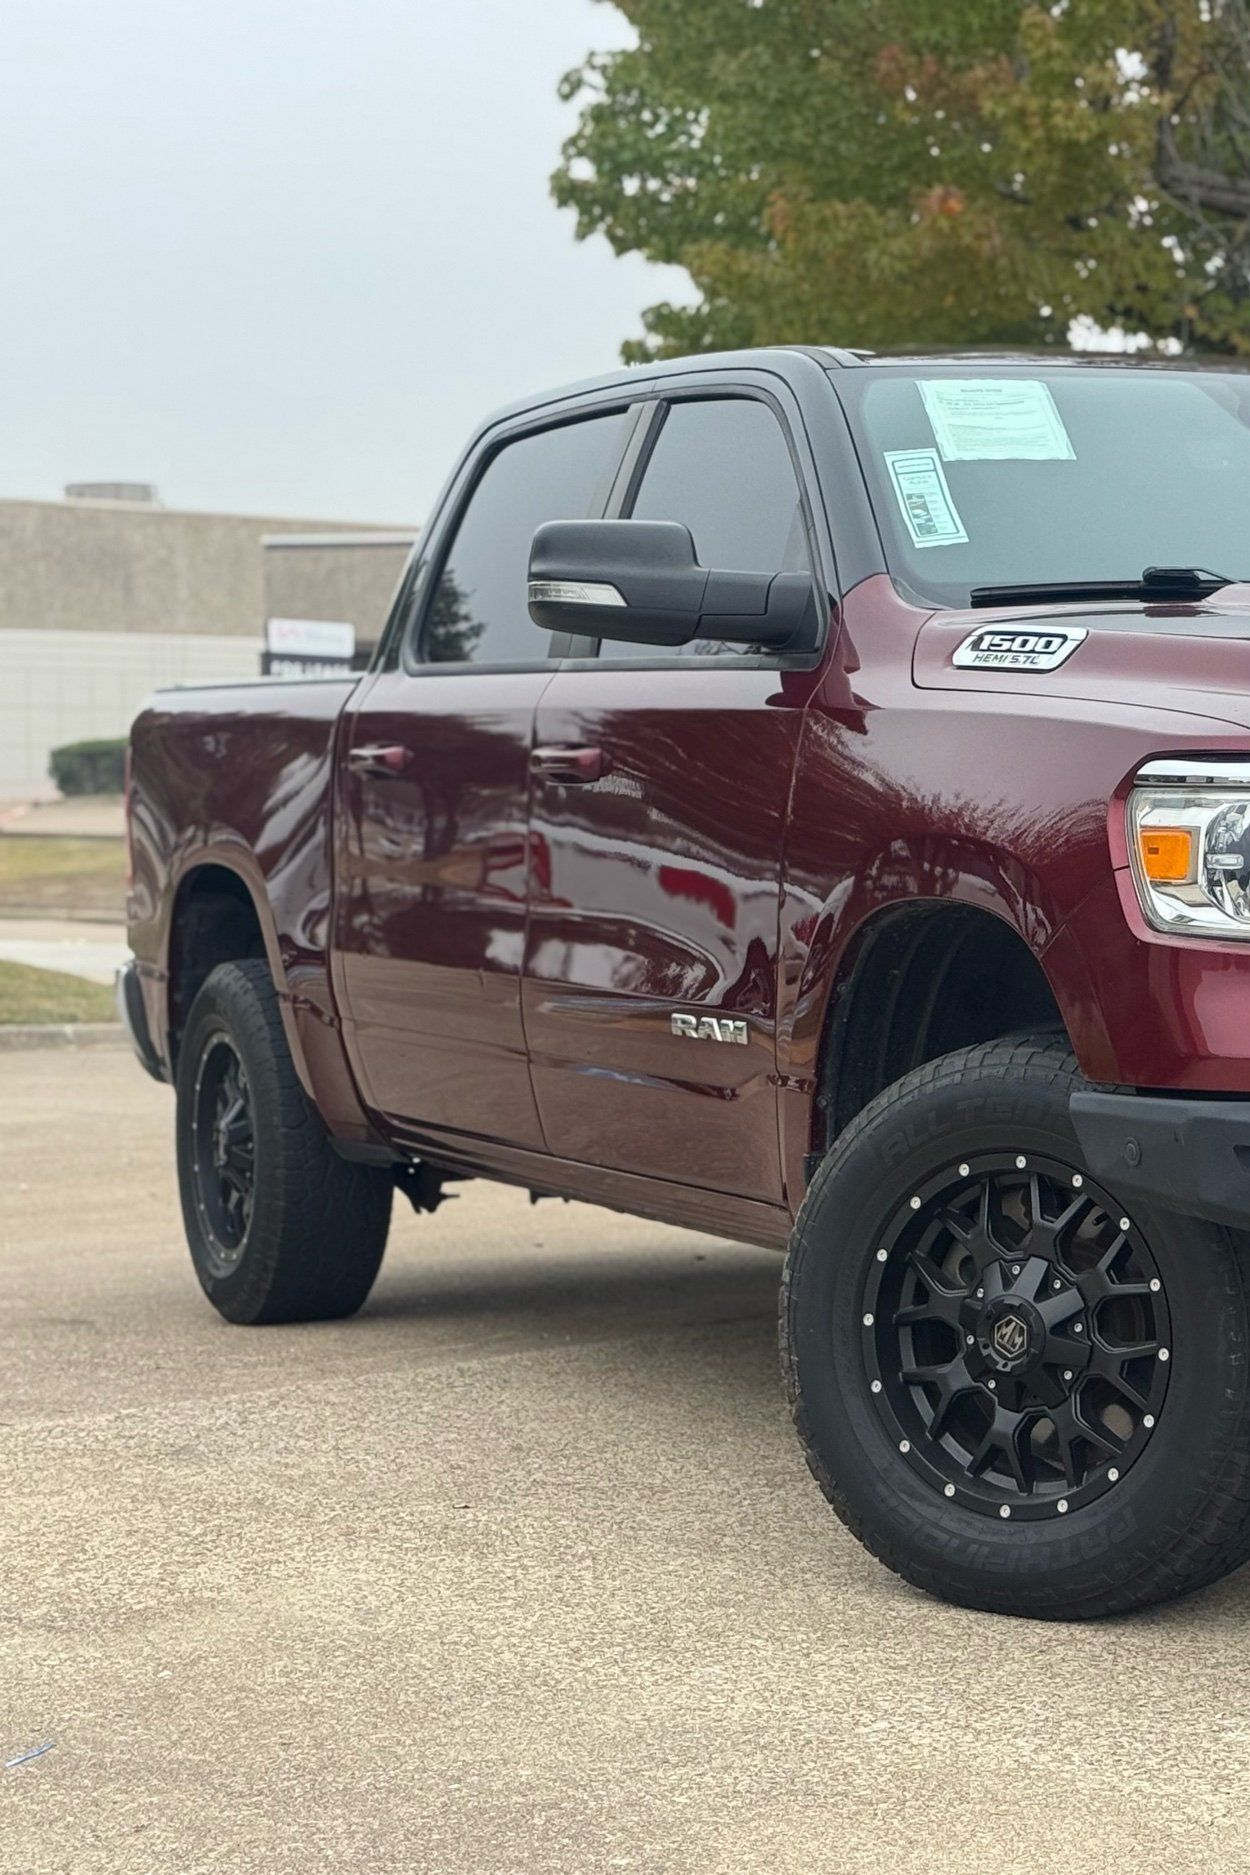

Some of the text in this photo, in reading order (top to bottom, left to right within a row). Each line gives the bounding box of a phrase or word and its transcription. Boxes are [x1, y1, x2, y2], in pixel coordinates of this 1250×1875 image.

[979, 635, 1063, 652] 1500
[972, 654, 1040, 664] HEMI 5.7L
[671, 1012, 749, 1046] RAM
